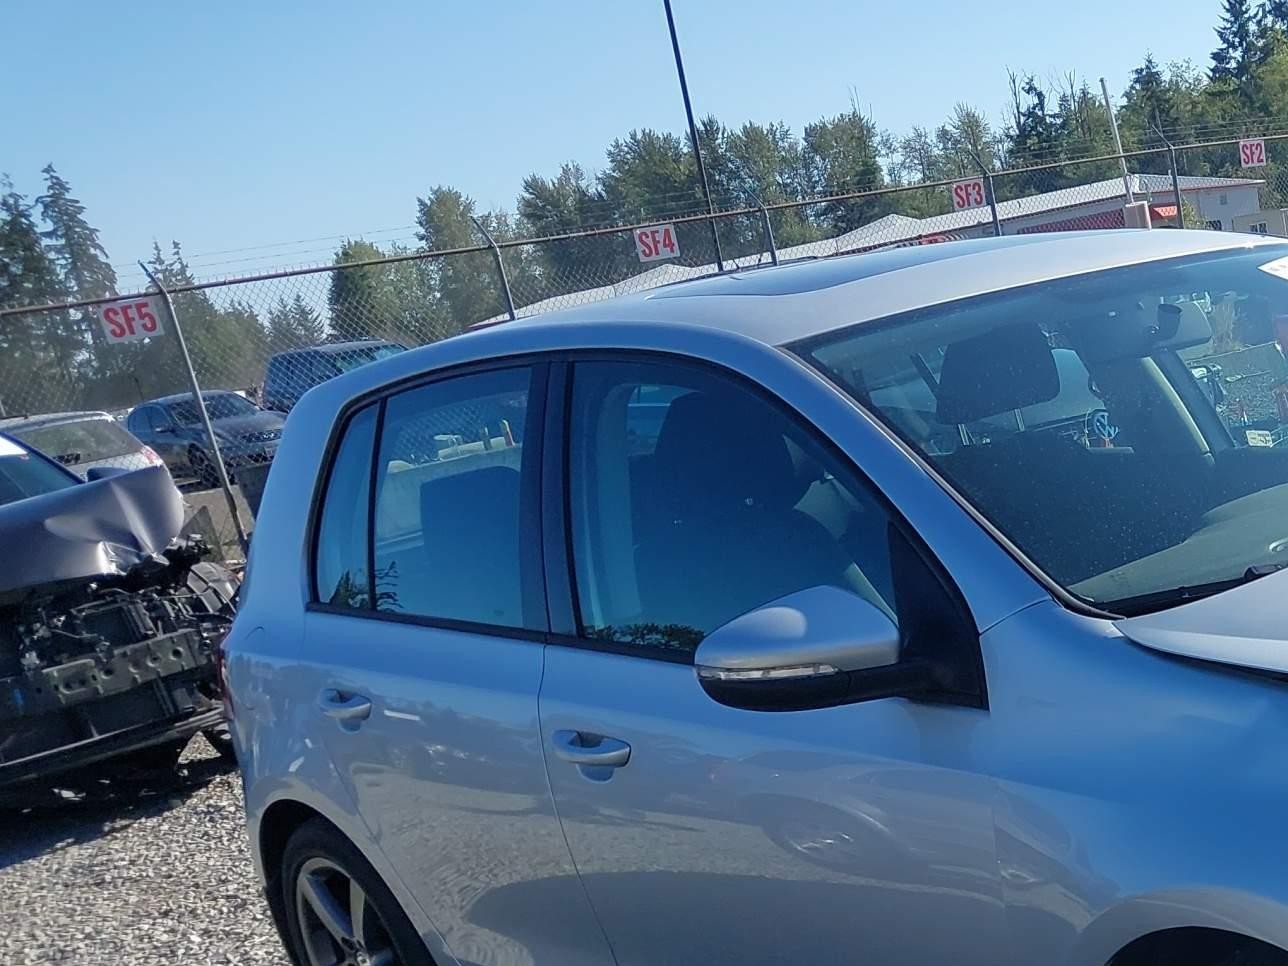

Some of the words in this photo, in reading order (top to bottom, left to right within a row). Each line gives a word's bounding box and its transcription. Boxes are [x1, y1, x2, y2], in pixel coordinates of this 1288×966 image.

[1241, 142, 1264, 165] SF2
[954, 182, 984, 208] SF3
[638, 228, 675, 257] SF4
[103, 301, 157, 338] SF5
